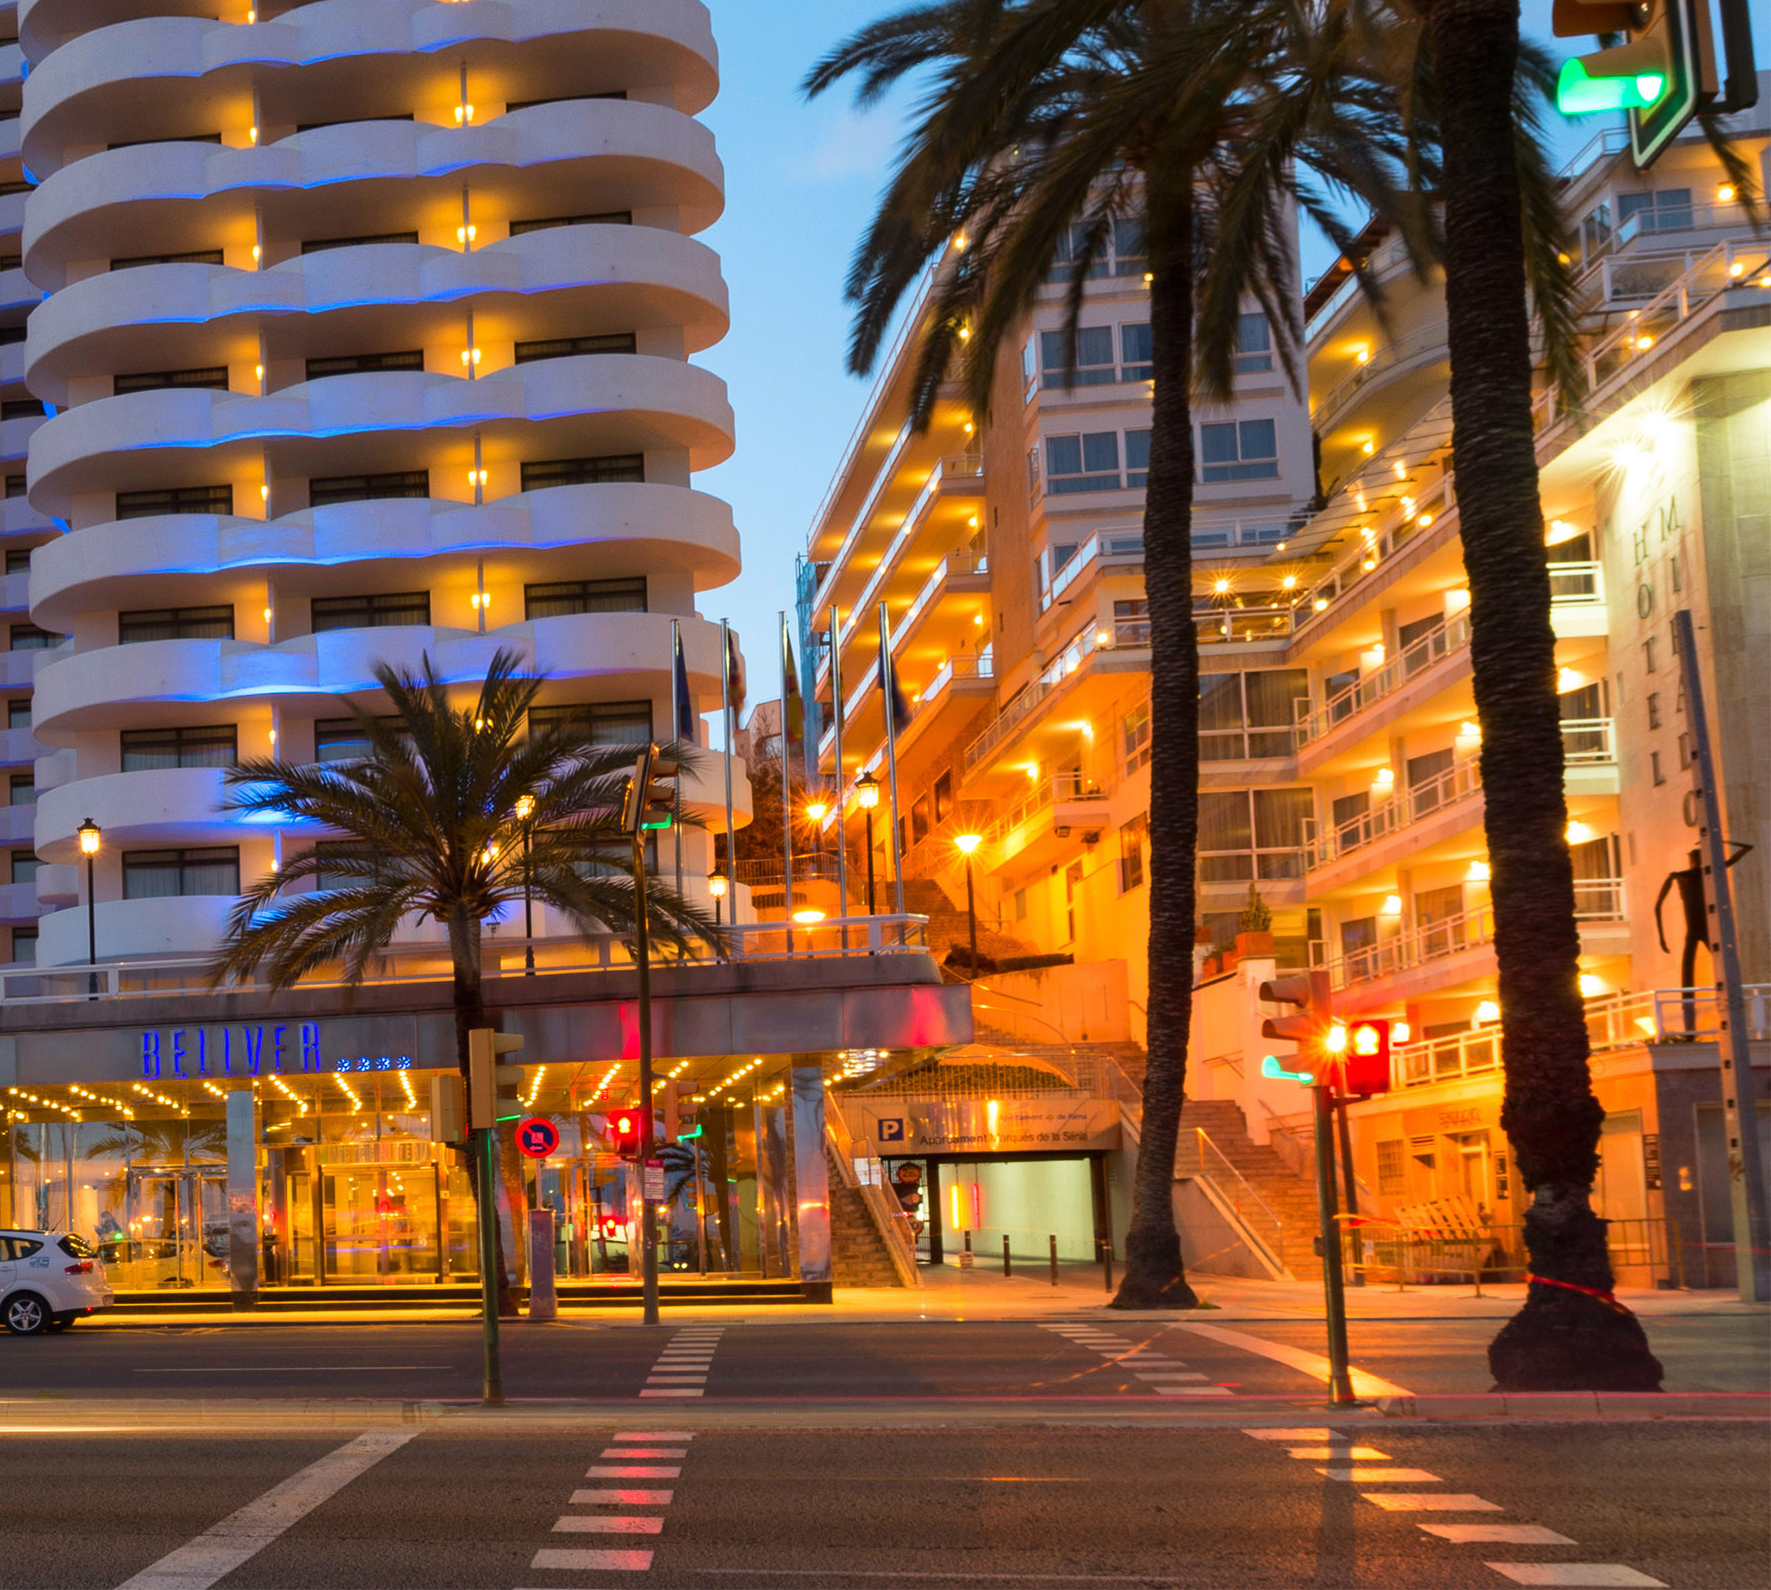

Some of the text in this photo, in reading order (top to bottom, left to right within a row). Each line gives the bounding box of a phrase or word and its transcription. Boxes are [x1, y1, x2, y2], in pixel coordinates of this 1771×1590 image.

[1633, 521, 1666, 789] HOTEL
[140, 1021, 320, 1081] BELLVER
[1036, 1132, 1050, 1142] de
[1051, 1131, 1061, 1141] la
